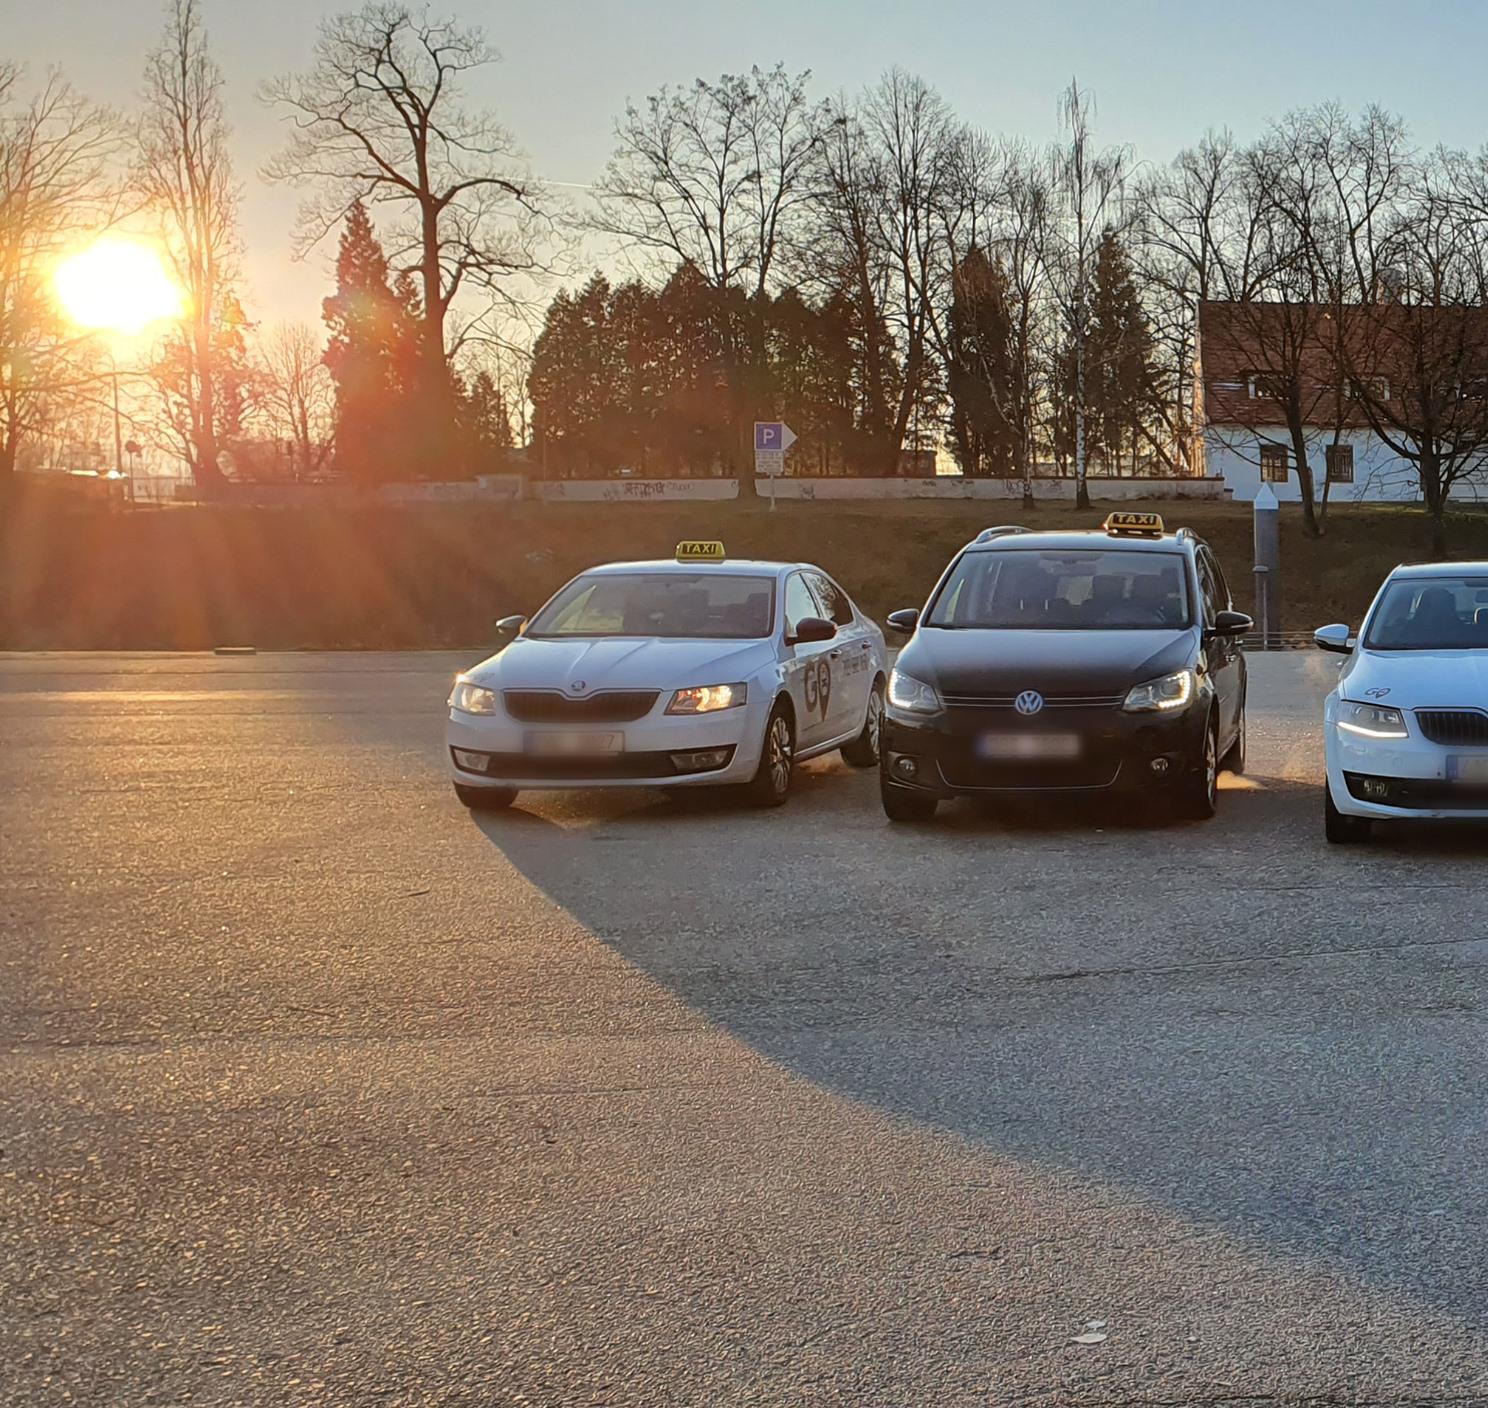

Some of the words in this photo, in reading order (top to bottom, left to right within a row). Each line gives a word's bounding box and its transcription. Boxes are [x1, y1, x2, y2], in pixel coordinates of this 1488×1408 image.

[763, 428, 775, 445] P
[1117, 514, 1155, 524] TAXI
[684, 543, 715, 553] TAXI
